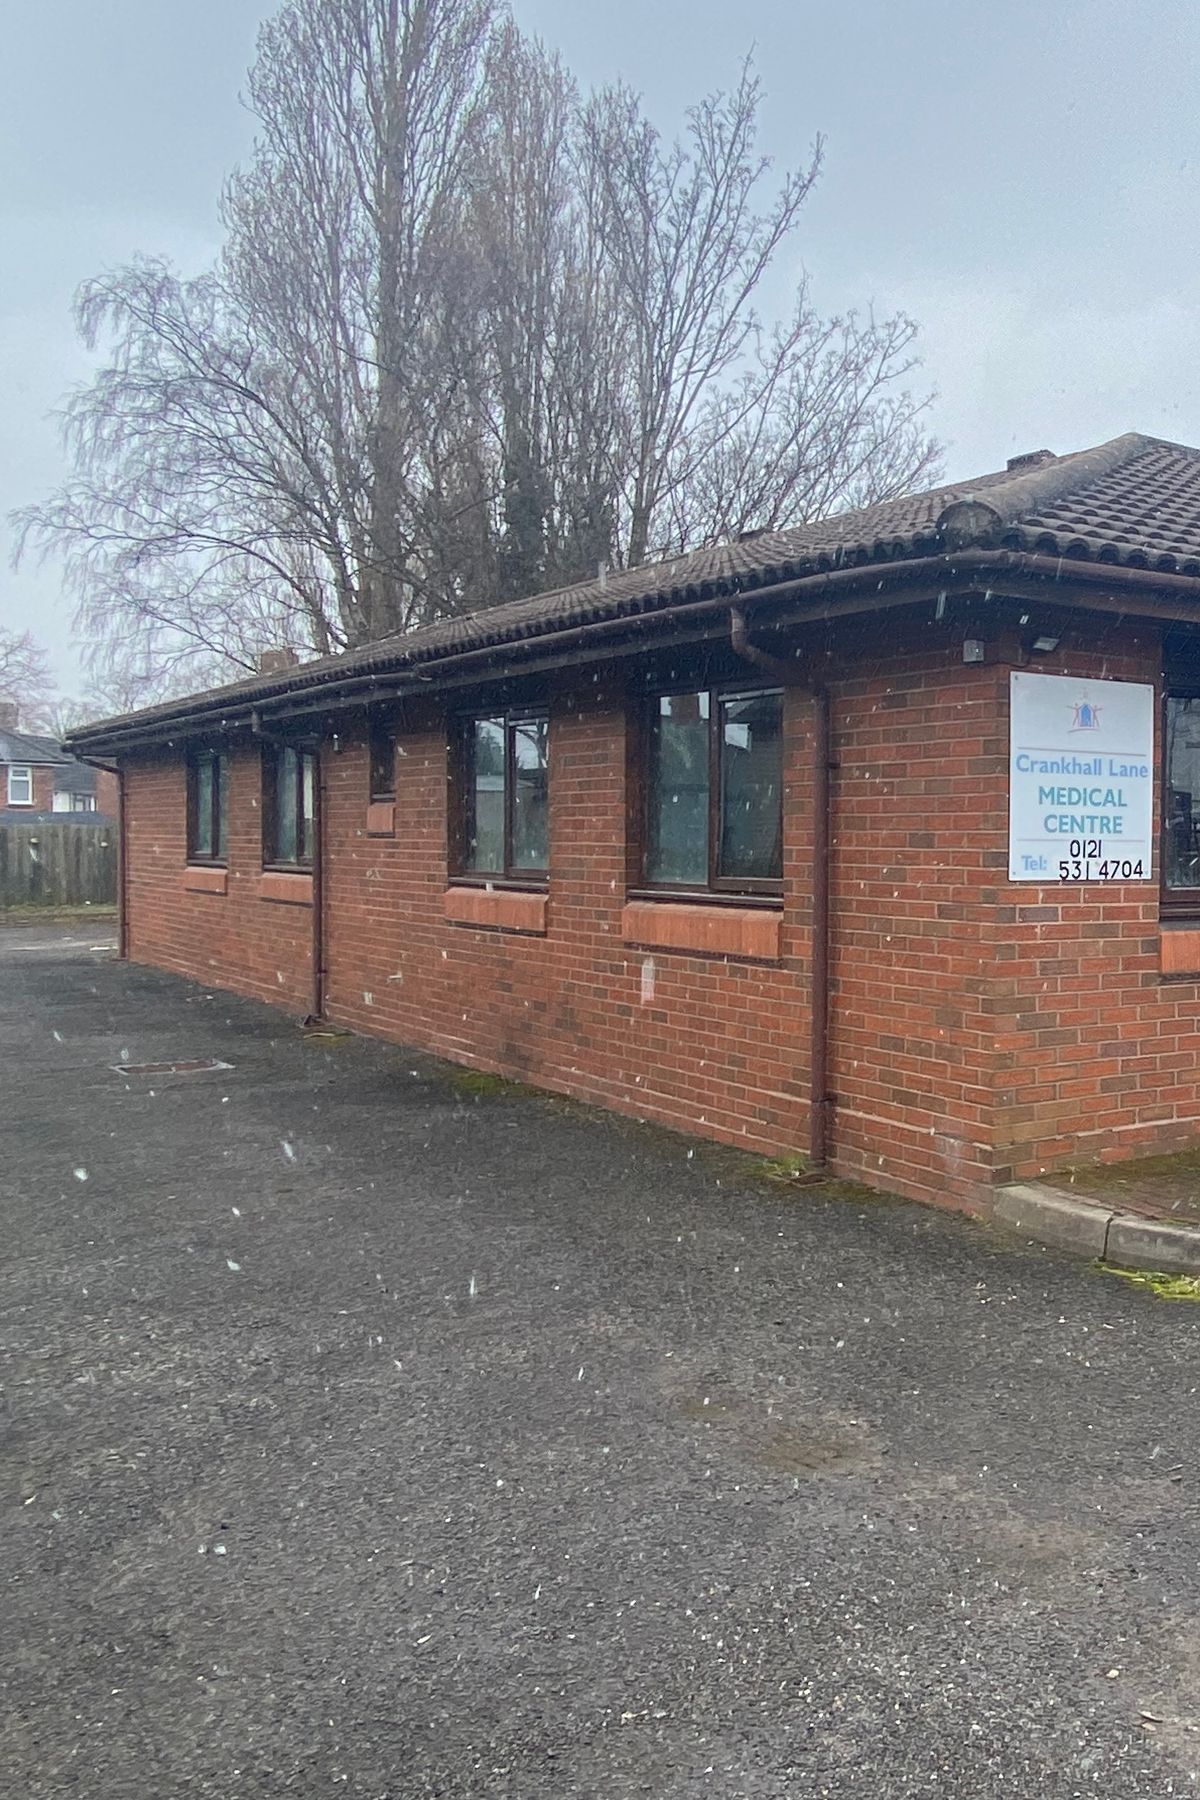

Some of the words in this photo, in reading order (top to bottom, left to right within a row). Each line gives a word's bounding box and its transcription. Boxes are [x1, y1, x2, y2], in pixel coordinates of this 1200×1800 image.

[1016, 754, 1102, 776] Crankhall
[1109, 759, 1149, 777] Lane
[1038, 786, 1127, 807] MEDICAL
[1044, 814, 1123, 834] CENTRE
[1070, 840, 1102, 858] 0121
[1021, 855, 1047, 871] Tel:
[1059, 861, 1089, 880] 531
[1098, 860, 1144, 879] 4704
